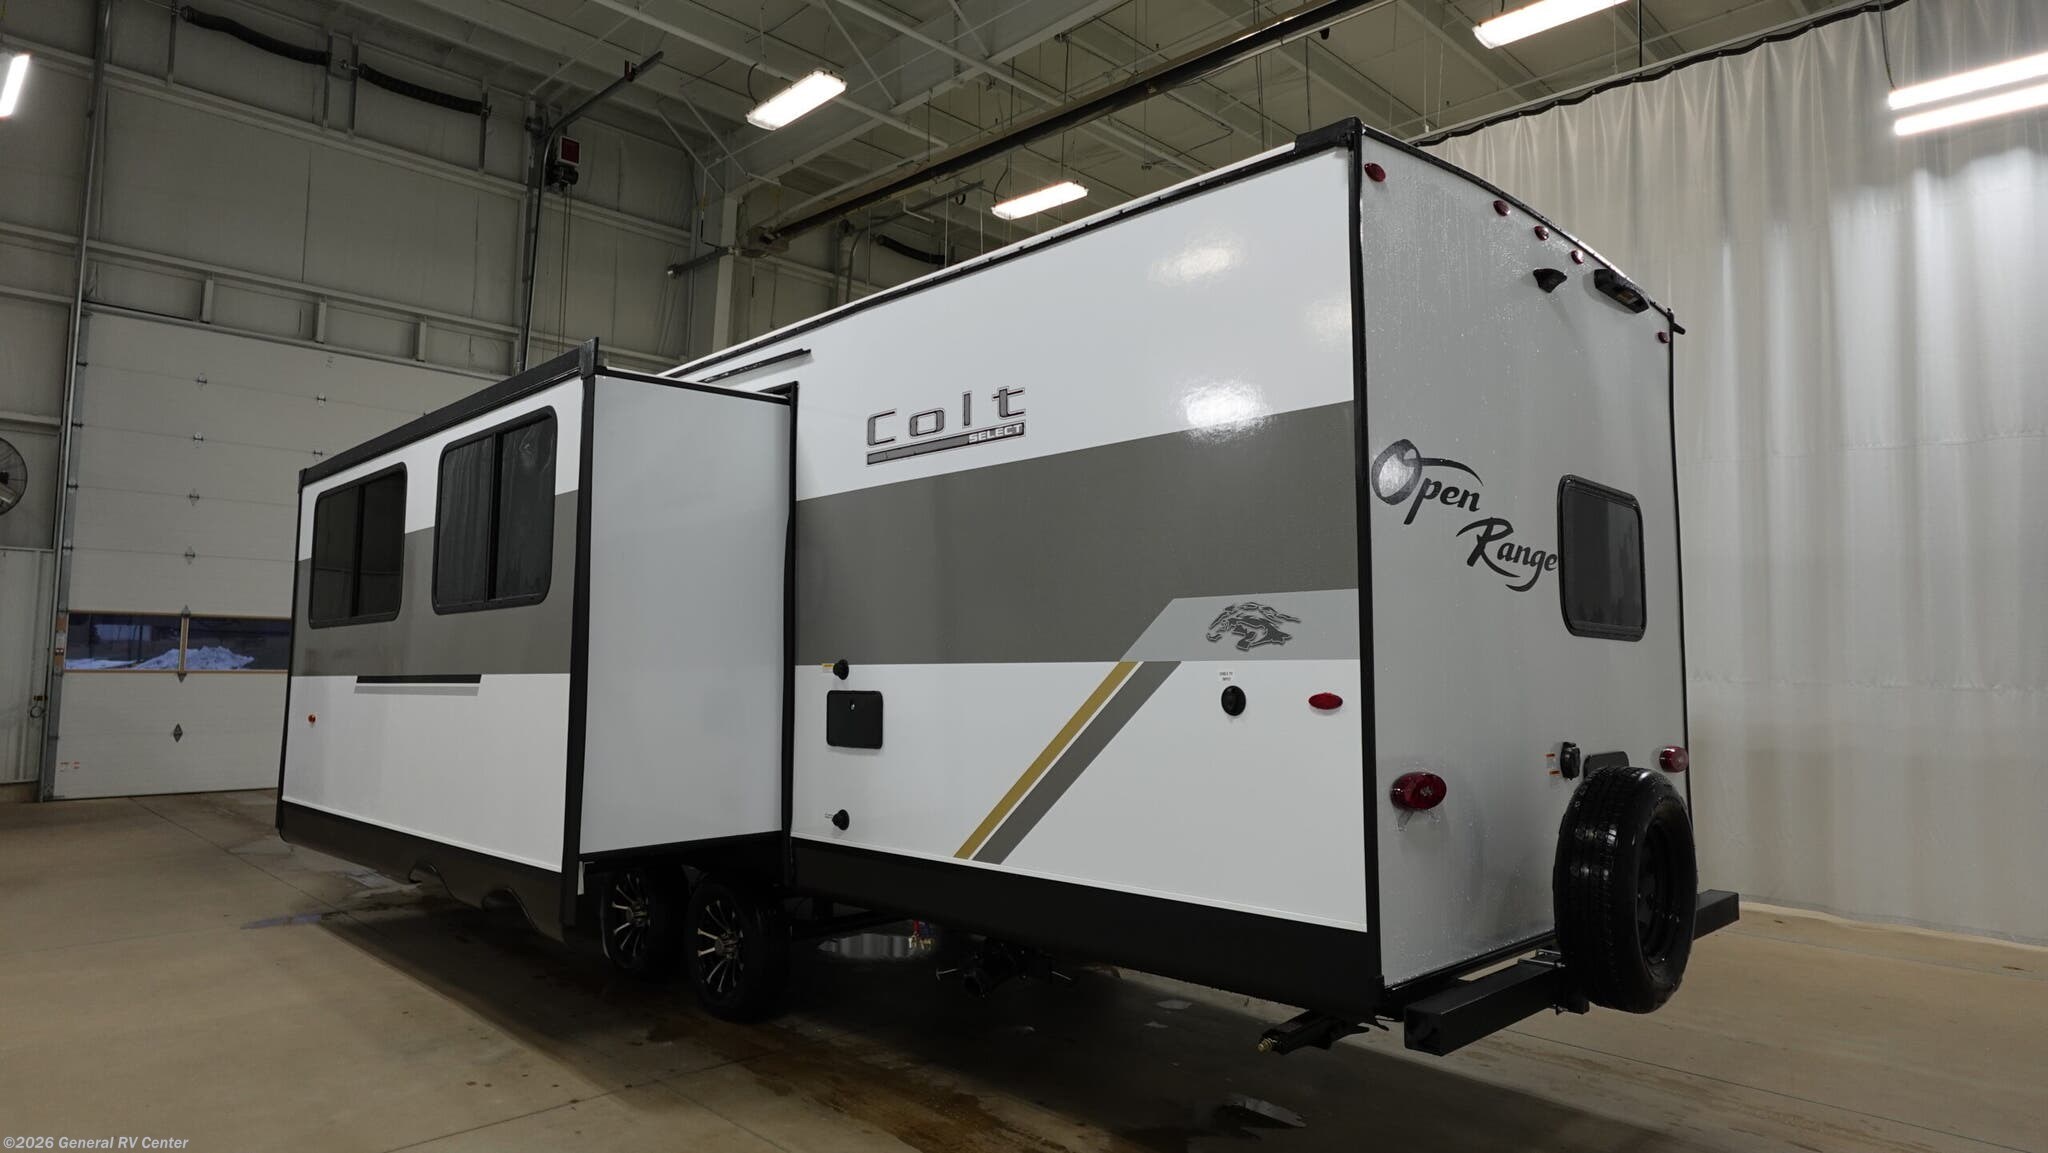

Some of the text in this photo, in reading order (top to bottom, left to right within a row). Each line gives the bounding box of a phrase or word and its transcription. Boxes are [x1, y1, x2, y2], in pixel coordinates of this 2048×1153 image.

[968, 422, 1024, 444] SELECT
[1371, 439, 1484, 525] Open
[1456, 517, 1558, 592] Range
